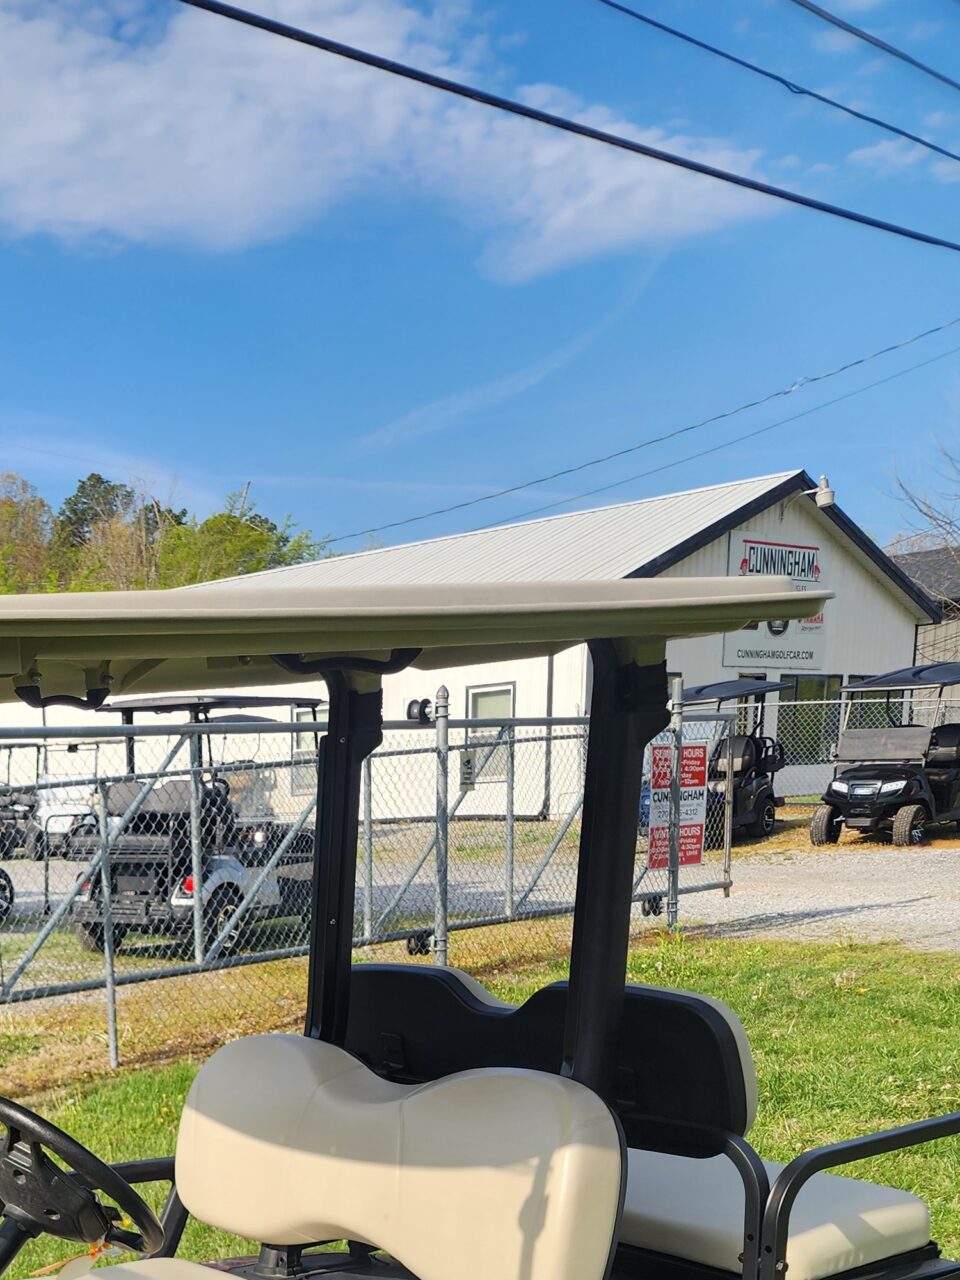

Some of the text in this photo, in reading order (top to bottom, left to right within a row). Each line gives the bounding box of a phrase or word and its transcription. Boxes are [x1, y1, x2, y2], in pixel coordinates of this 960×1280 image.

[748, 546, 815, 578] CUNNINGHAM
[737, 649, 814, 660] CUNNINGHAMGOLFCAR.COM
[683, 749, 704, 758] HOURS
